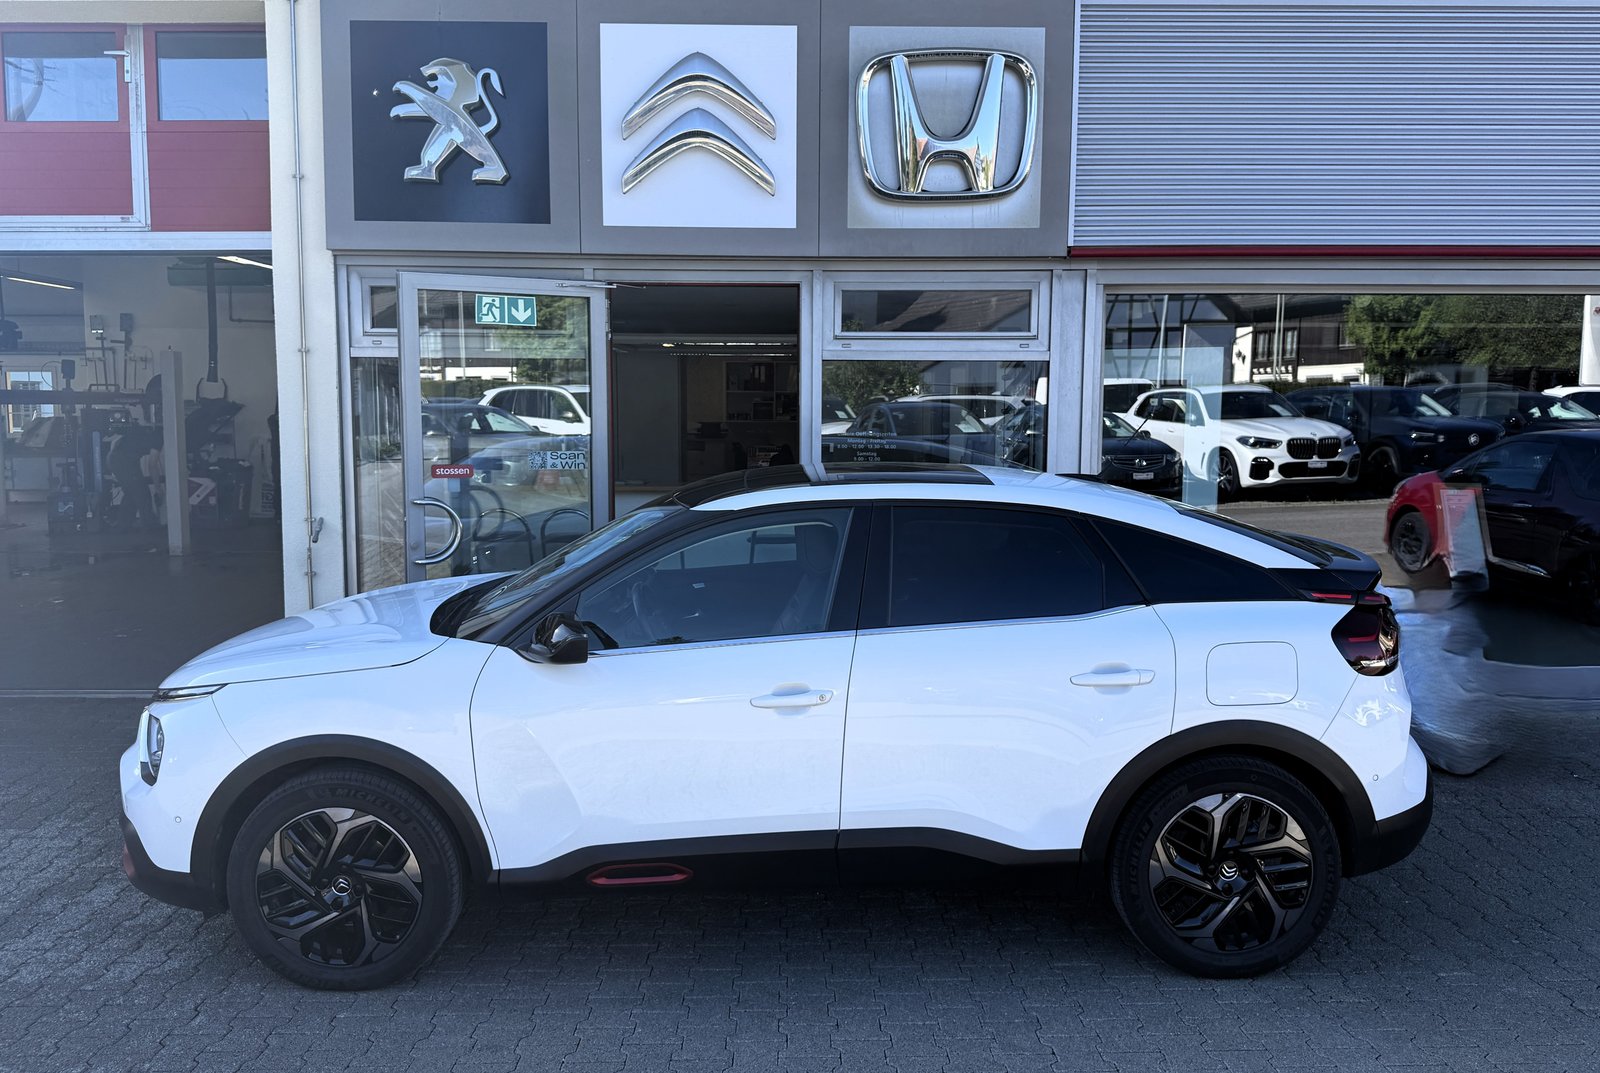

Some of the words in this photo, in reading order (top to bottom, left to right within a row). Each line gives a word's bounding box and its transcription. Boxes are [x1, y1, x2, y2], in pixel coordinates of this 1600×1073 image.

[550, 451, 586, 460] Scan
[560, 460, 586, 470] Win
[435, 467, 470, 475] stossen
[334, 787, 413, 824] MICHELIN
[1127, 819, 1153, 895] MICHELIN
